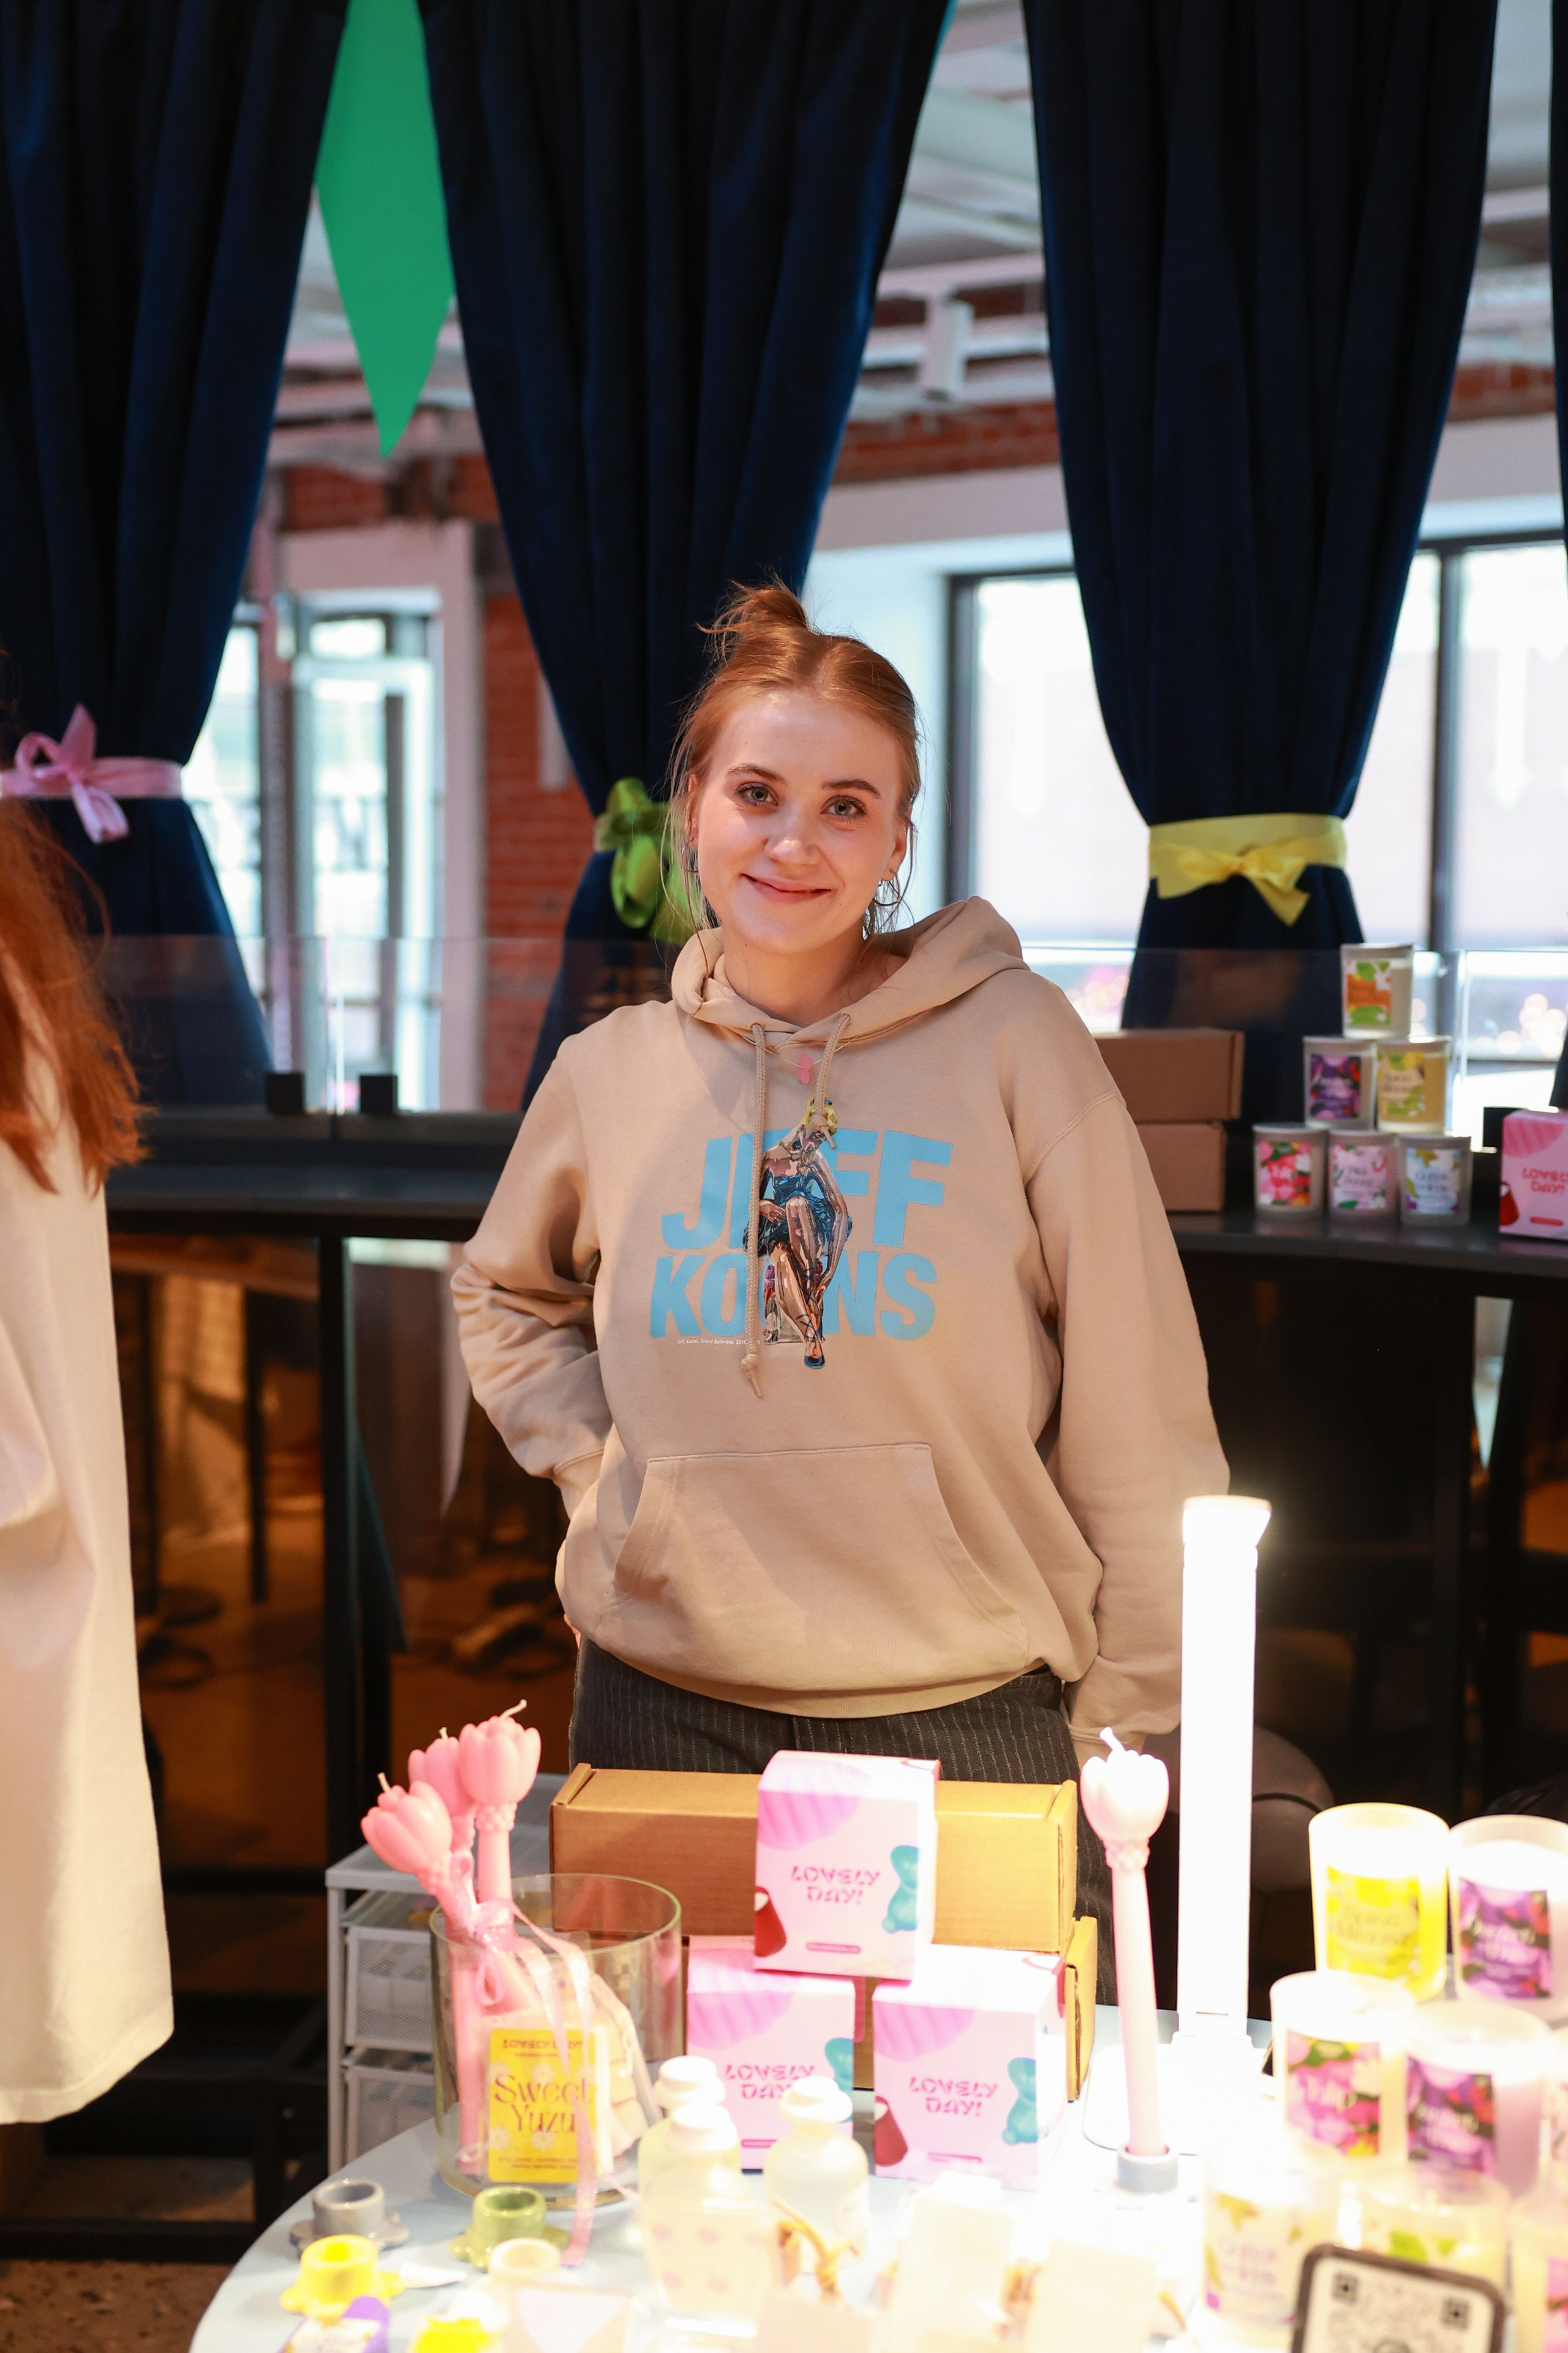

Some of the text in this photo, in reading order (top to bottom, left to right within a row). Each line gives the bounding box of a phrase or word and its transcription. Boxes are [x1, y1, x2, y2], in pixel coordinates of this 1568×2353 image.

[1522, 1168, 1568, 1184] LOVEL
[650, 1250, 937, 1340] KONS
[791, 1865, 880, 1886] LOVELY
[807, 1886, 863, 1905] DAY!
[725, 2065, 815, 2080] LOVELY
[494, 2074, 592, 2104] Sweet
[741, 2084, 791, 2099] DAY
[910, 2077, 998, 2098] LOVELY
[925, 2097, 982, 2116] DAY!
[511, 2104, 577, 2134] Yuzu
